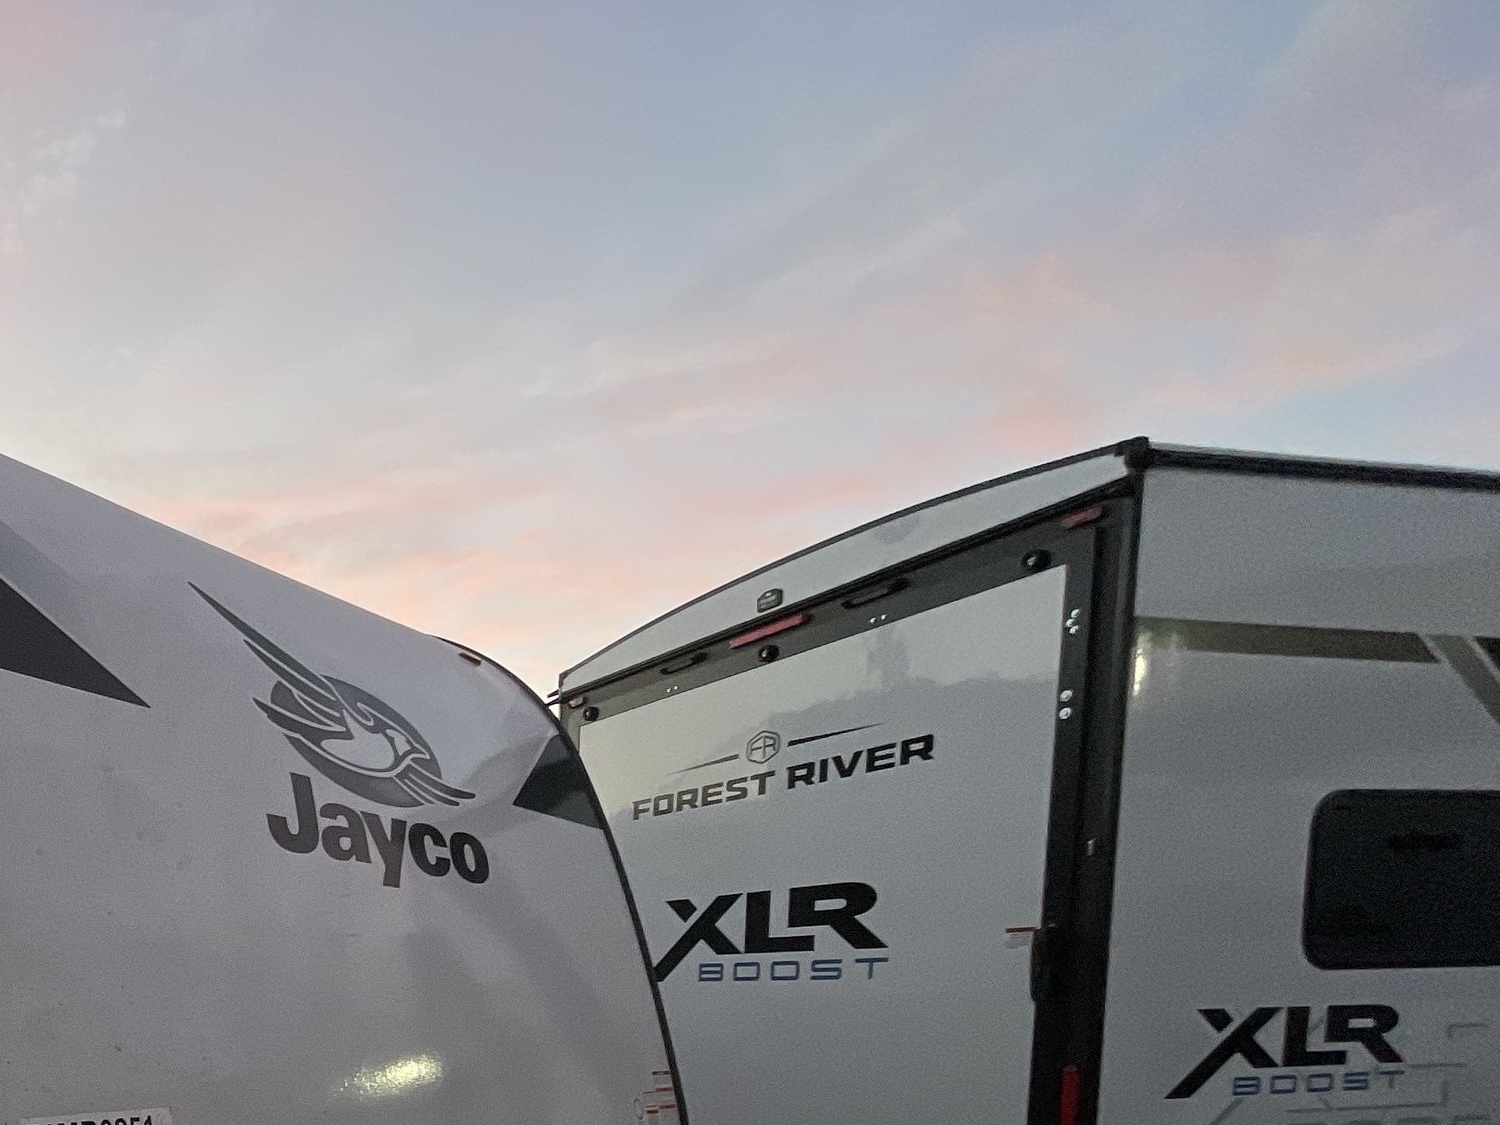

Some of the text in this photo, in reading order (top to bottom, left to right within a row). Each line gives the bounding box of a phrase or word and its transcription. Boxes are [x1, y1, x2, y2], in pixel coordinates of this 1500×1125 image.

[632, 734, 934, 820] FOREST RIVER
[266, 772, 490, 888] Jayco
[651, 882, 888, 982] XLR
[698, 957, 889, 982] BOOST
[1164, 1004, 1404, 1099] XLR
[1233, 1070, 1405, 1096] BOOST
